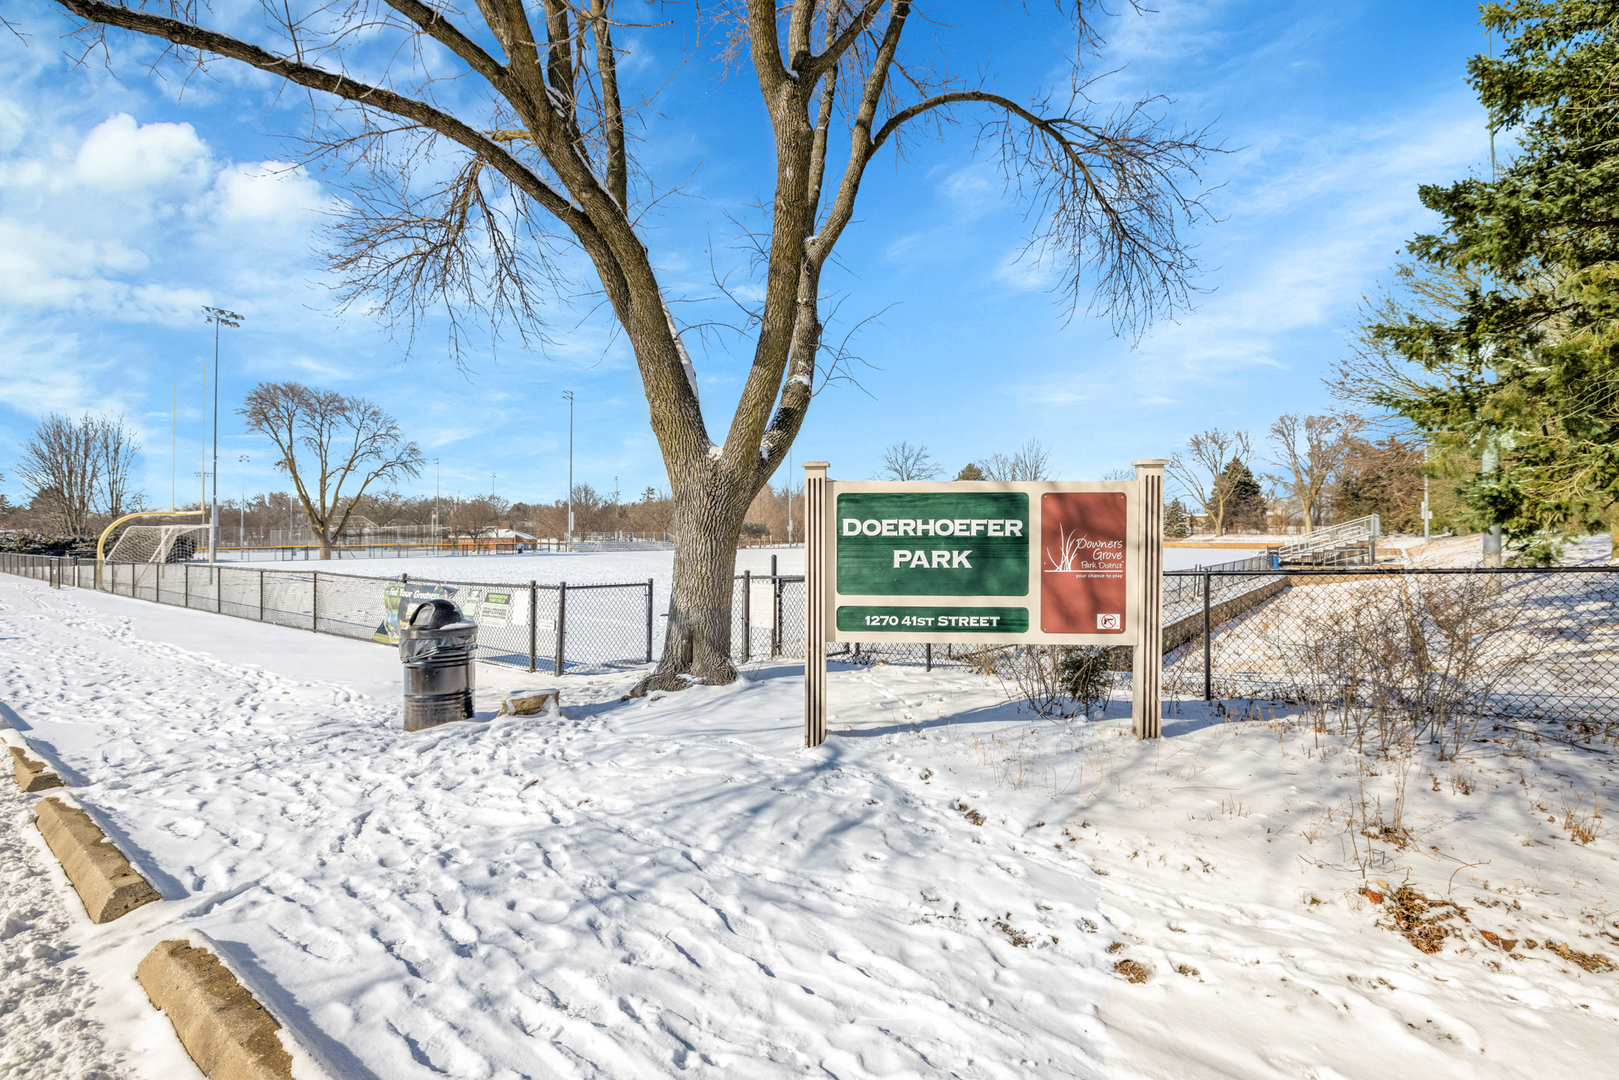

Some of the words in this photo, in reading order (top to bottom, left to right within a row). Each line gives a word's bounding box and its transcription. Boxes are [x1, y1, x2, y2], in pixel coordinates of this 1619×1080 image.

[842, 518, 1023, 537] DOERHOEFER
[1076, 537, 1123, 549] Downers
[893, 550, 973, 569] PARK
[1093, 548, 1123, 561] Grove
[1081, 560, 1097, 569] Park
[1098, 561, 1123, 569] District
[399, 588, 413, 598] Your
[865, 615, 899, 626] 1270
[937, 615, 1001, 627] STREET
